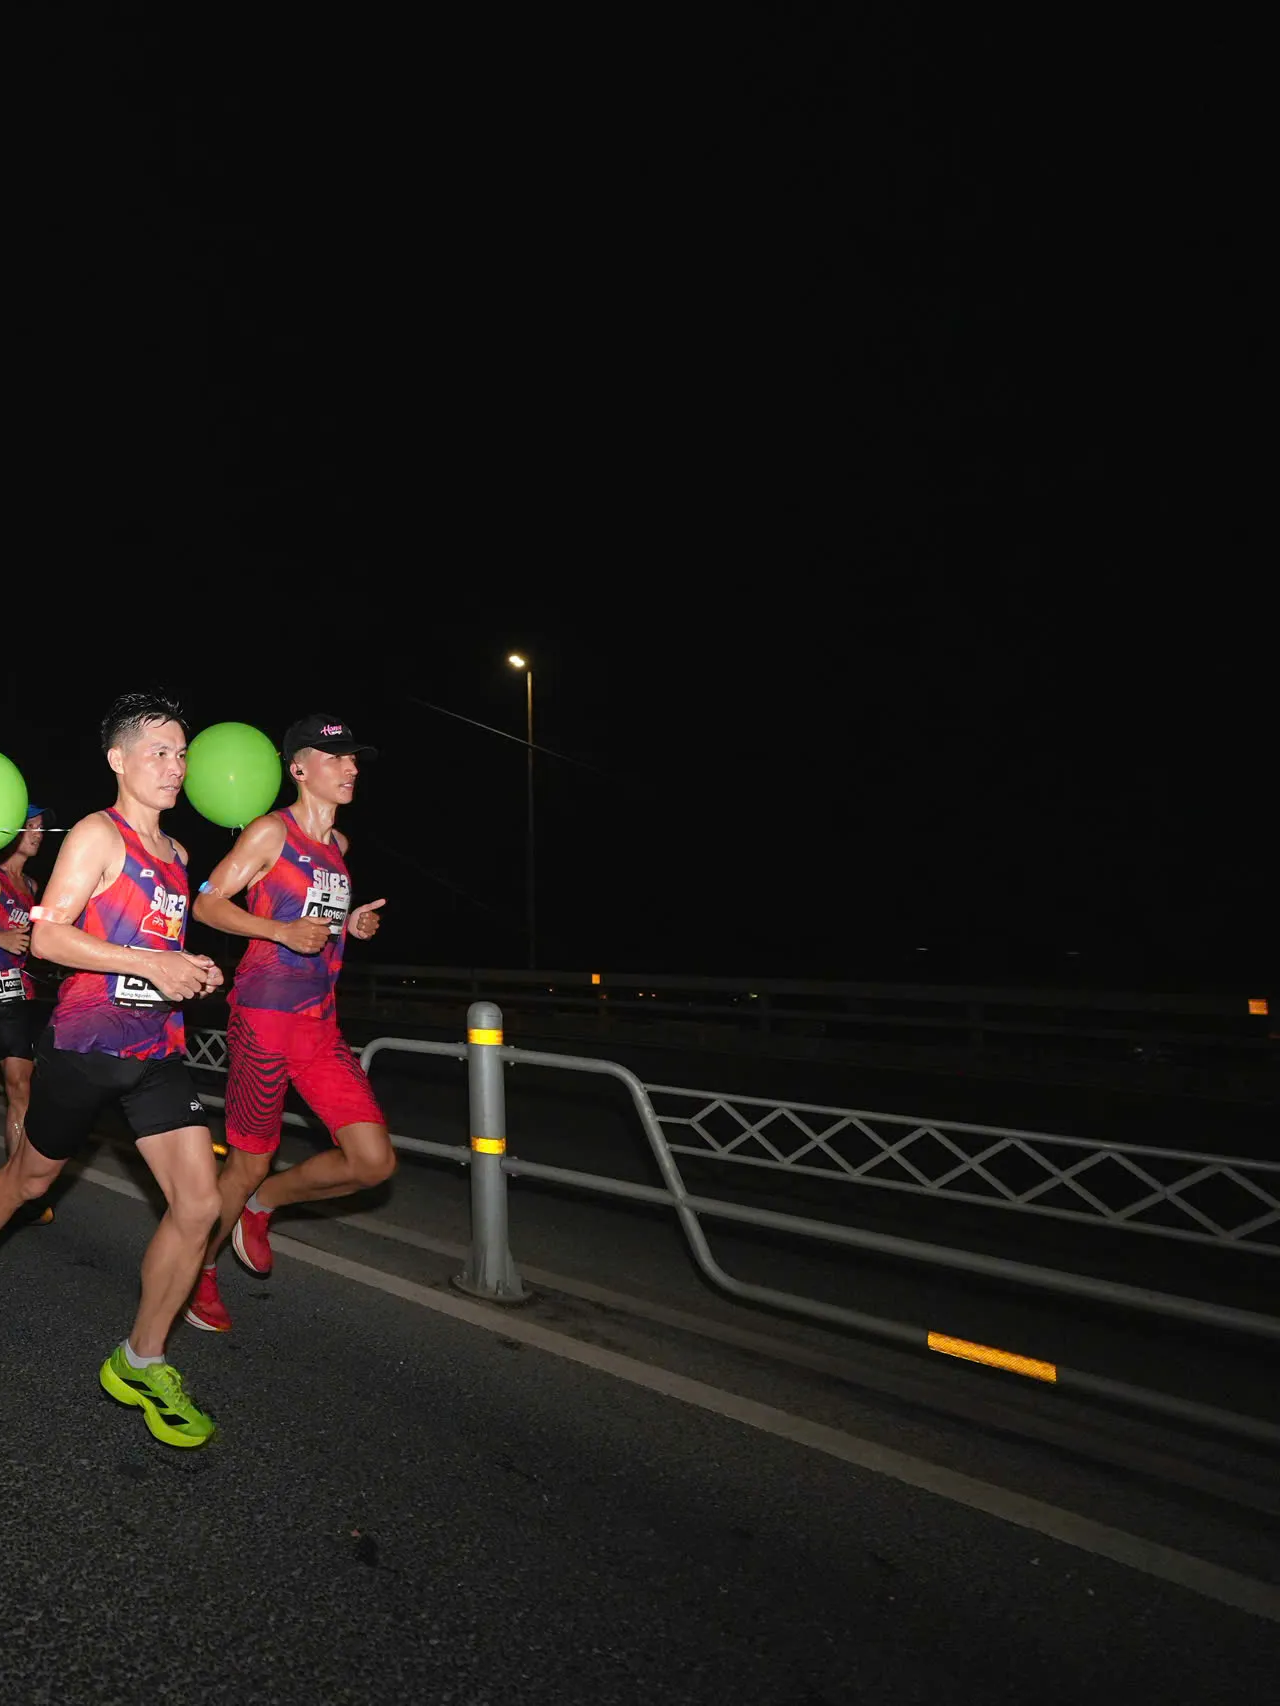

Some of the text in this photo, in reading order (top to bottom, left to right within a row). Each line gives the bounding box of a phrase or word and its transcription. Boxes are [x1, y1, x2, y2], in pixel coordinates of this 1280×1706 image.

[150, 886, 186, 918] SUB3
[9, 908, 30, 925] SUB
[309, 906, 318, 917] A
